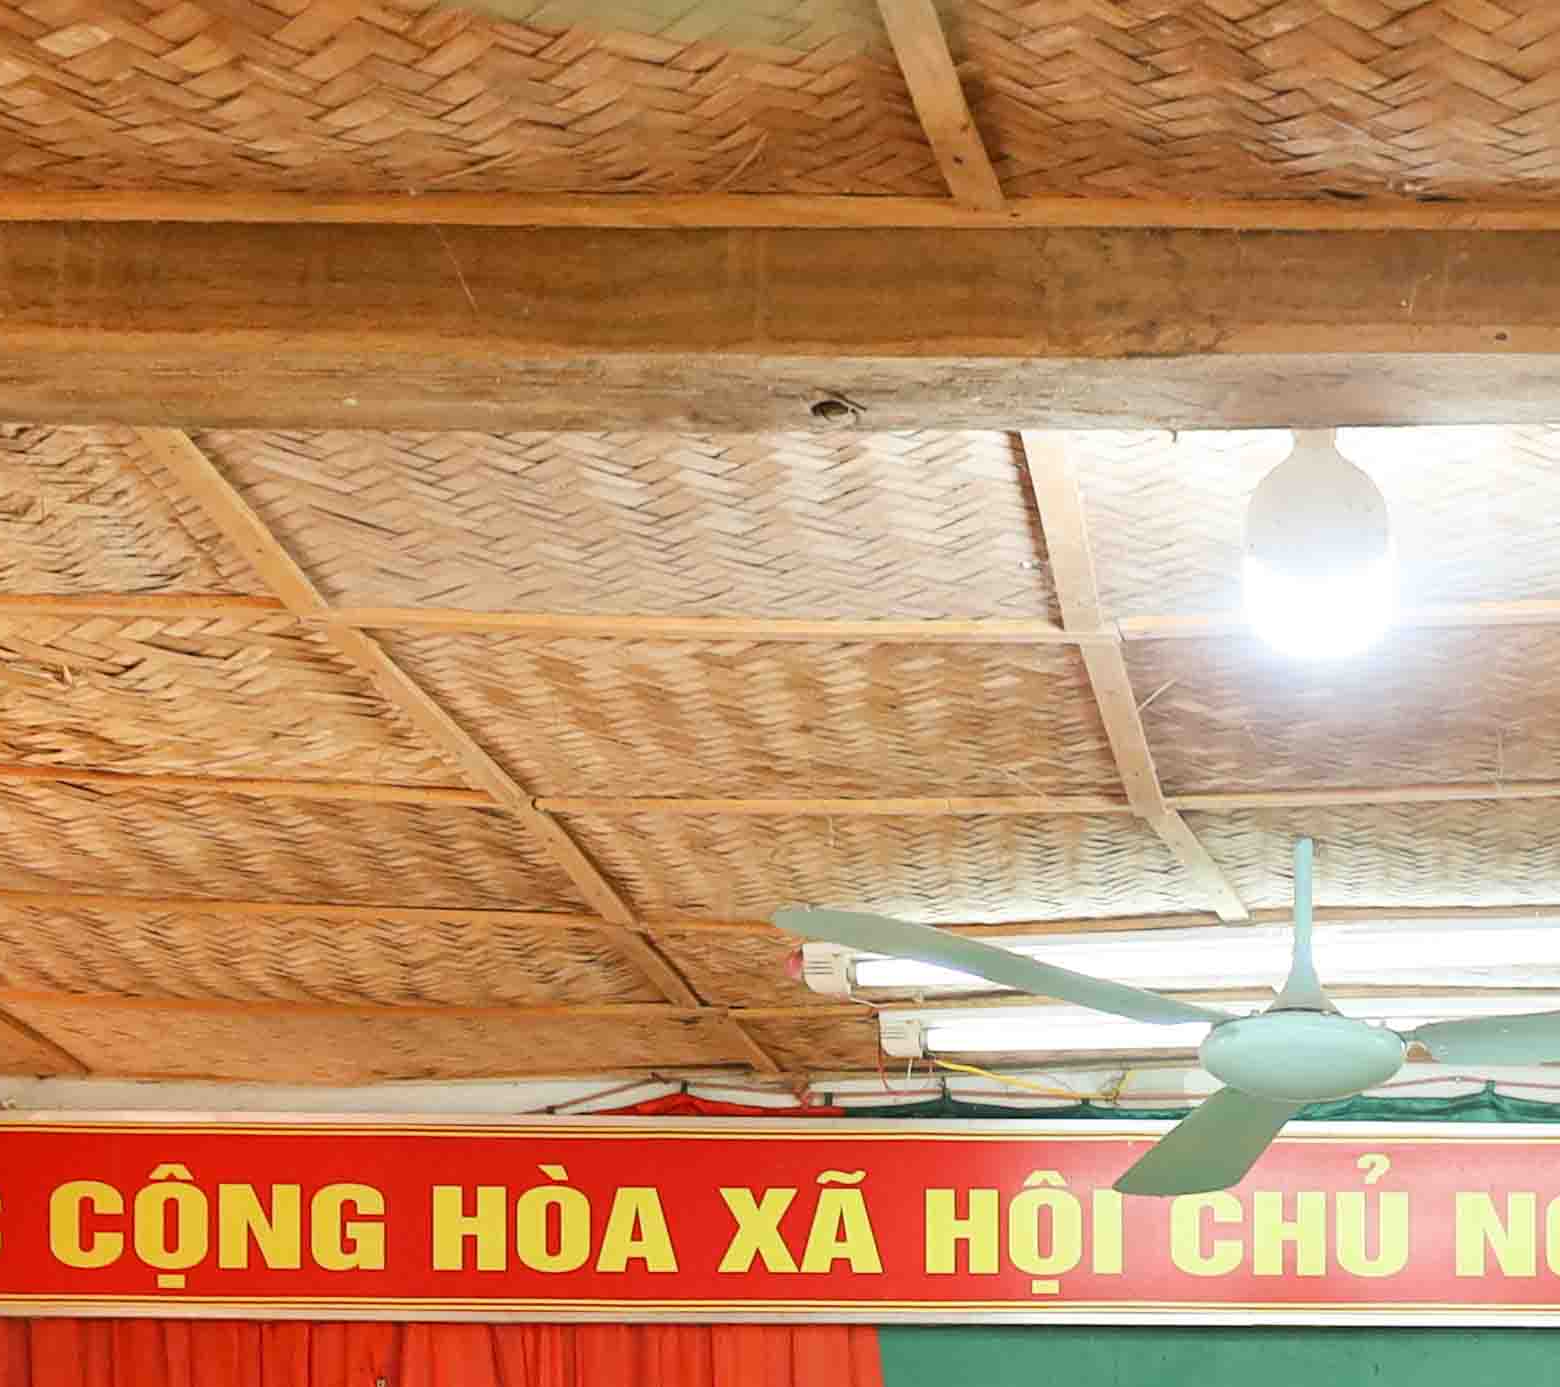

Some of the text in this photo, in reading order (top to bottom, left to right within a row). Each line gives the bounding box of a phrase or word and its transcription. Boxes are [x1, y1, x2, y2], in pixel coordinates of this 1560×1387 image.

[49, 1164, 385, 1289] CỘNG
[432, 1164, 679, 1274] HÒA
[717, 1169, 884, 1274] XÃ
[925, 1169, 1123, 1294] HỘI
[1170, 1152, 1409, 1278] CHỦ
